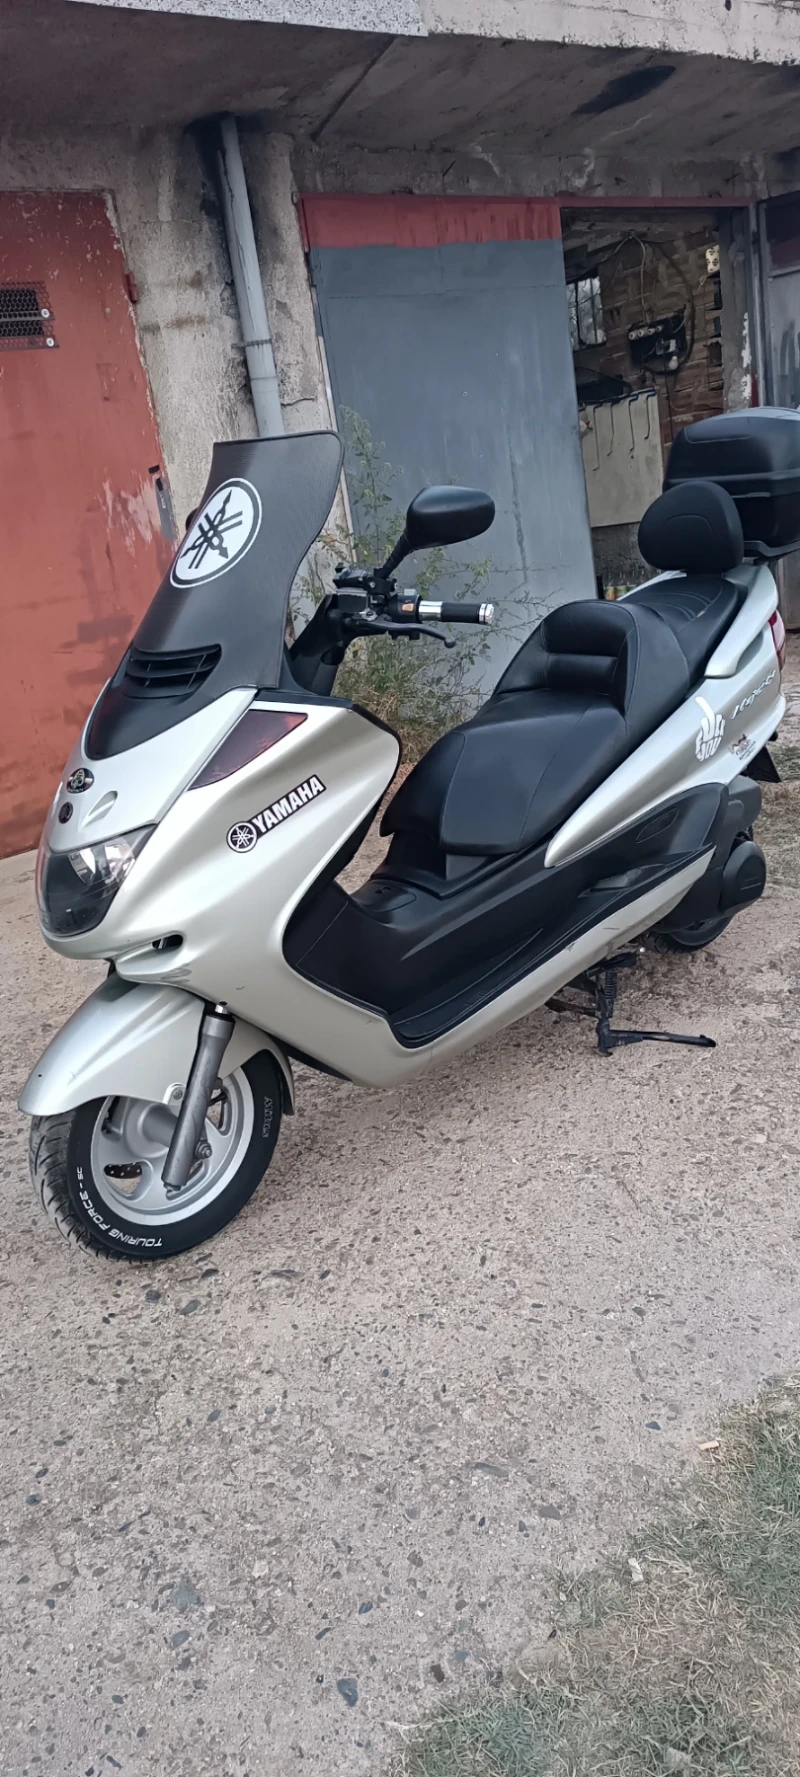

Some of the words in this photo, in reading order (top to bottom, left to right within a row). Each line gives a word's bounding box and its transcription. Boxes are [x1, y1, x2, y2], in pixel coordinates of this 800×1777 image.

[251, 776, 325, 833] YAMAHA
[80, 1190, 111, 1231] FORCE
[108, 1228, 163, 1247] TOURING
